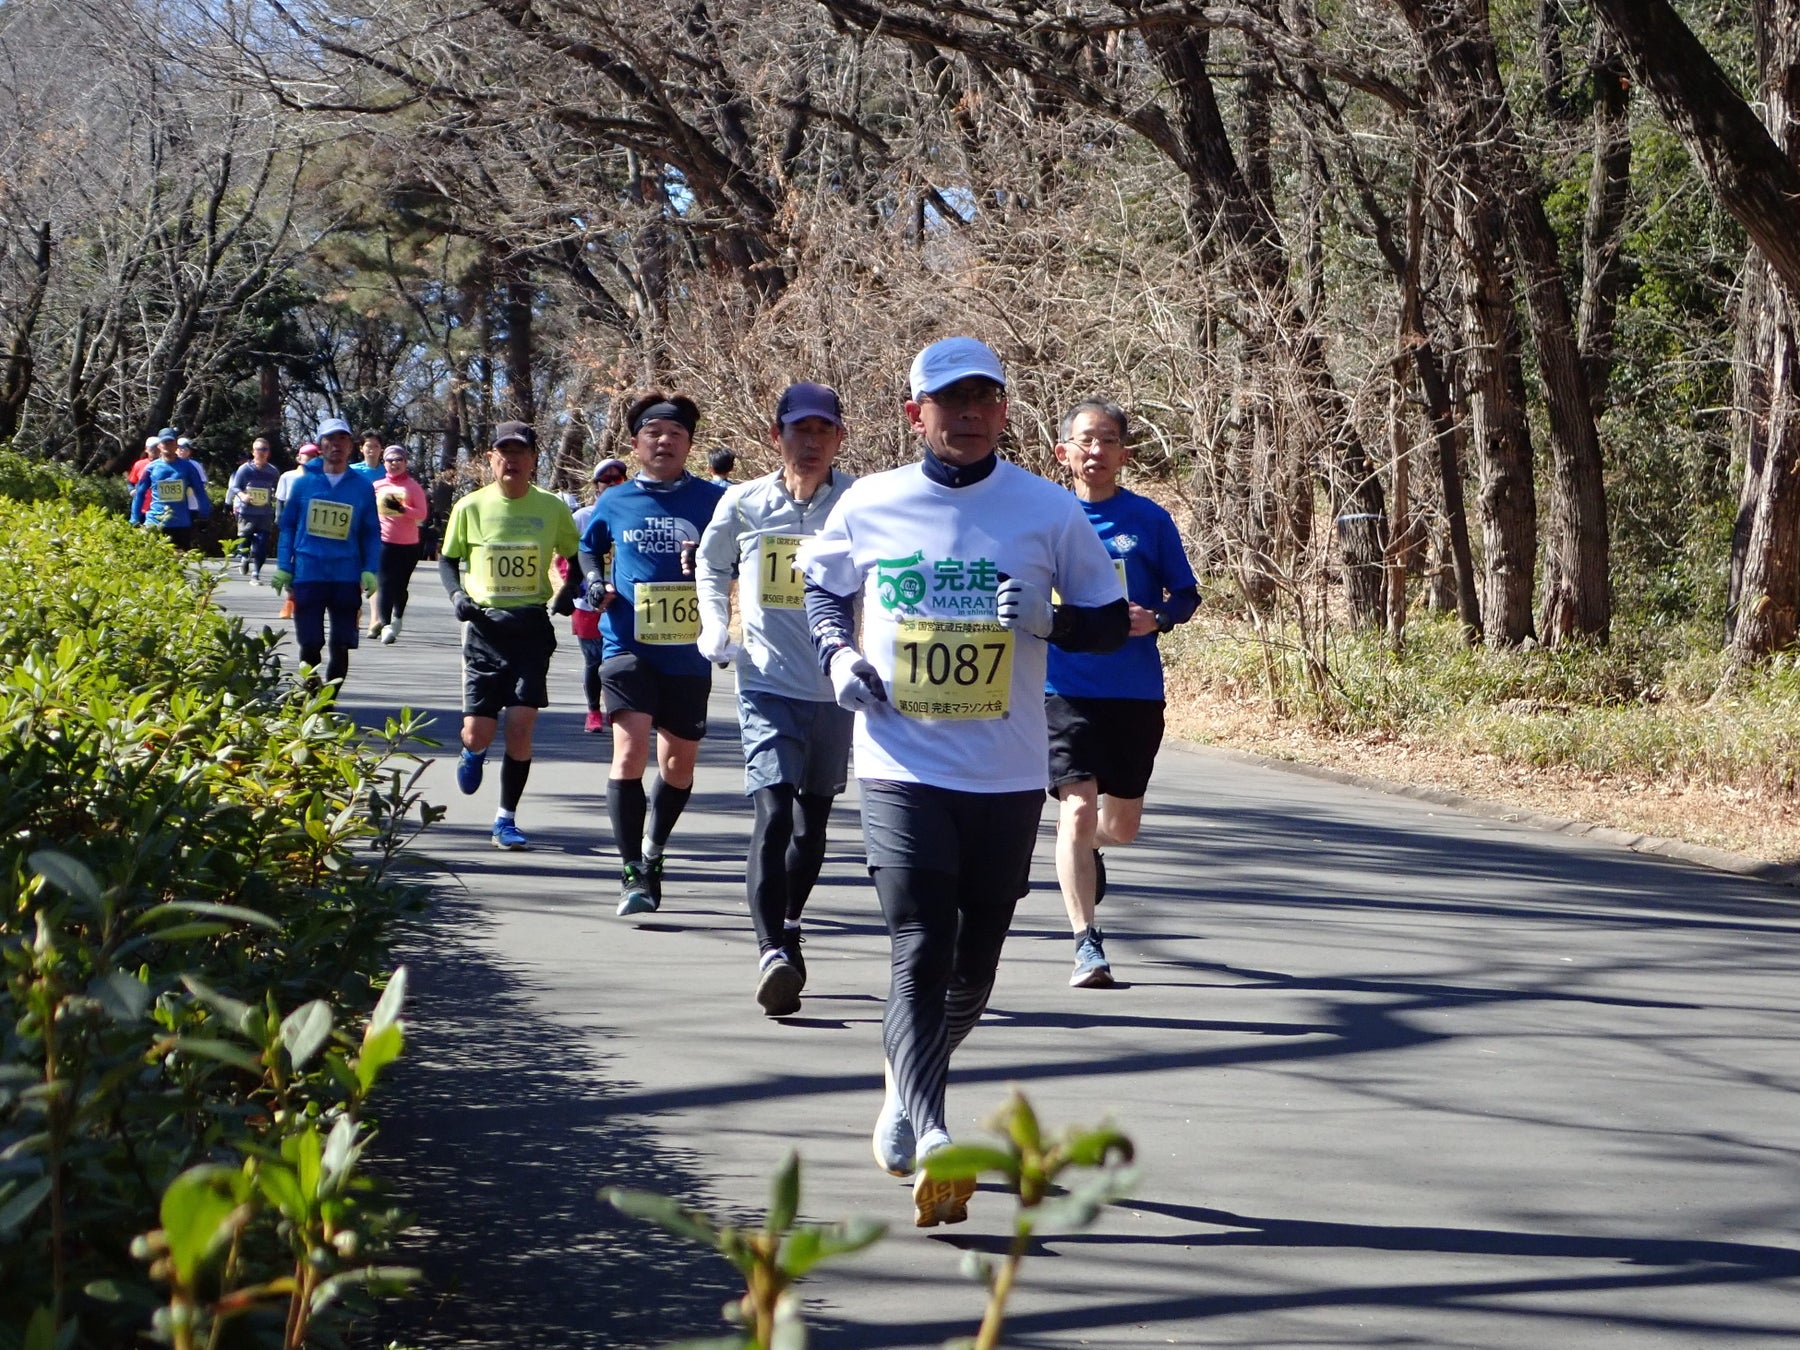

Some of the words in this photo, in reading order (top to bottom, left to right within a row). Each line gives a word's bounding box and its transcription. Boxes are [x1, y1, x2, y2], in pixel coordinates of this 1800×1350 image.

[312, 508, 349, 527] 1119
[645, 517, 674, 529] THE
[622, 529, 674, 542] NORTH
[638, 541, 674, 553] FACE
[486, 555, 537, 577] 1085
[766, 552, 806, 584] 11
[933, 557, 998, 591] 完走
[641, 597, 699, 623] 1168
[903, 642, 1006, 686] 1087
[899, 700, 929, 714] 第50回
[931, 700, 1003, 714] 完走マラソン大会
